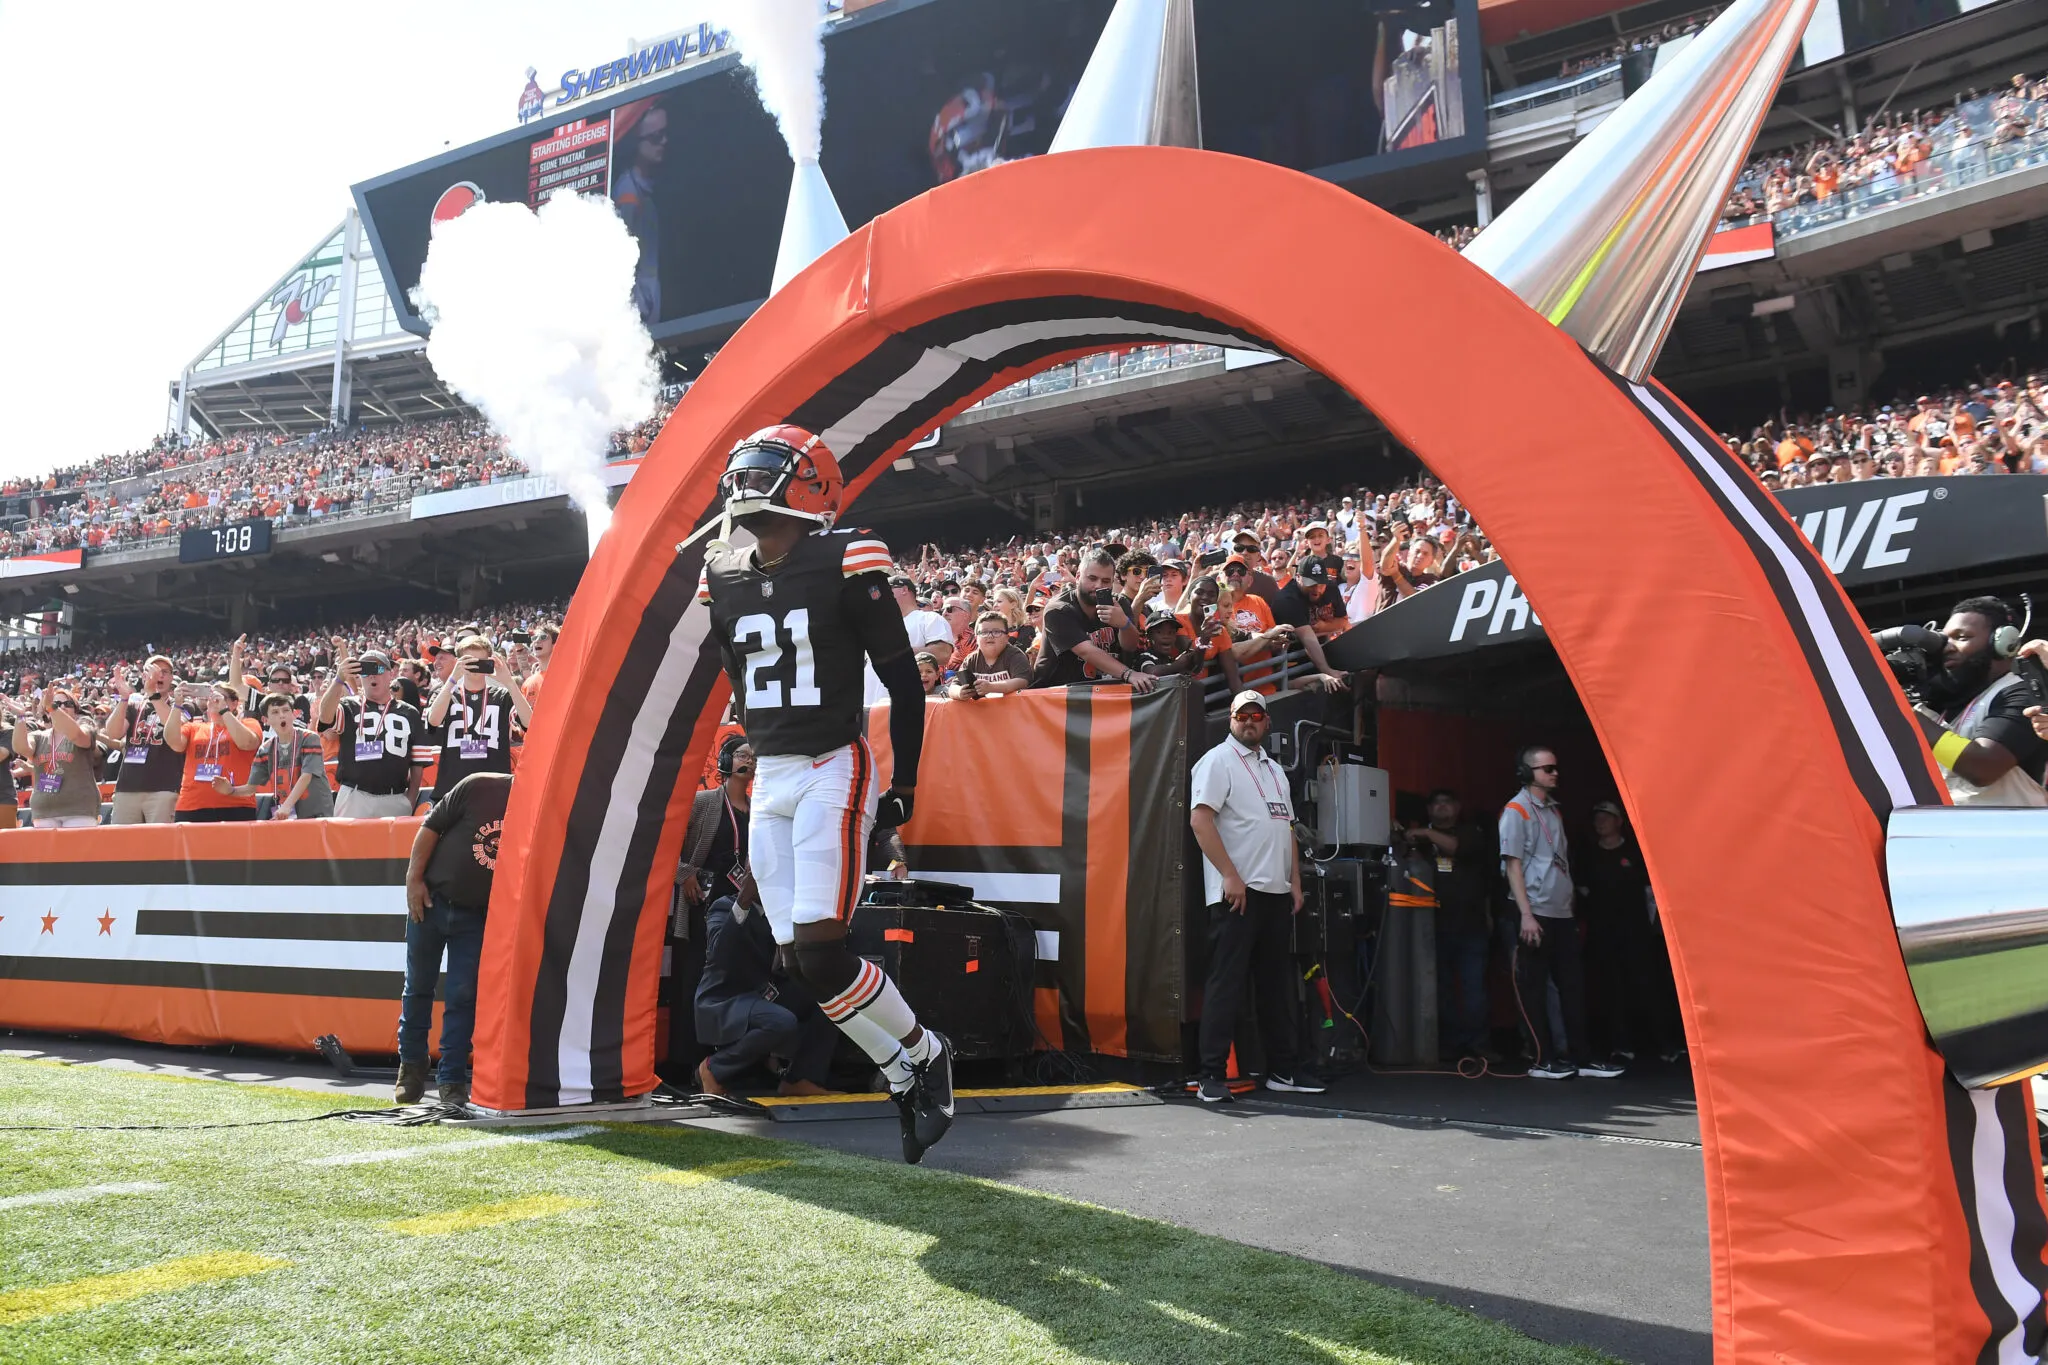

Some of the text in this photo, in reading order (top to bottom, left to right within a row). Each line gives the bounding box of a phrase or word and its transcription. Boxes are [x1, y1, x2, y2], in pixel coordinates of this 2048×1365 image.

[532, 125, 607, 159] STARTING DEFENSE
[211, 525, 252, 553] 7:08
[733, 608, 821, 709] 21
[354, 711, 411, 758] 28
[447, 703, 500, 750] 24
